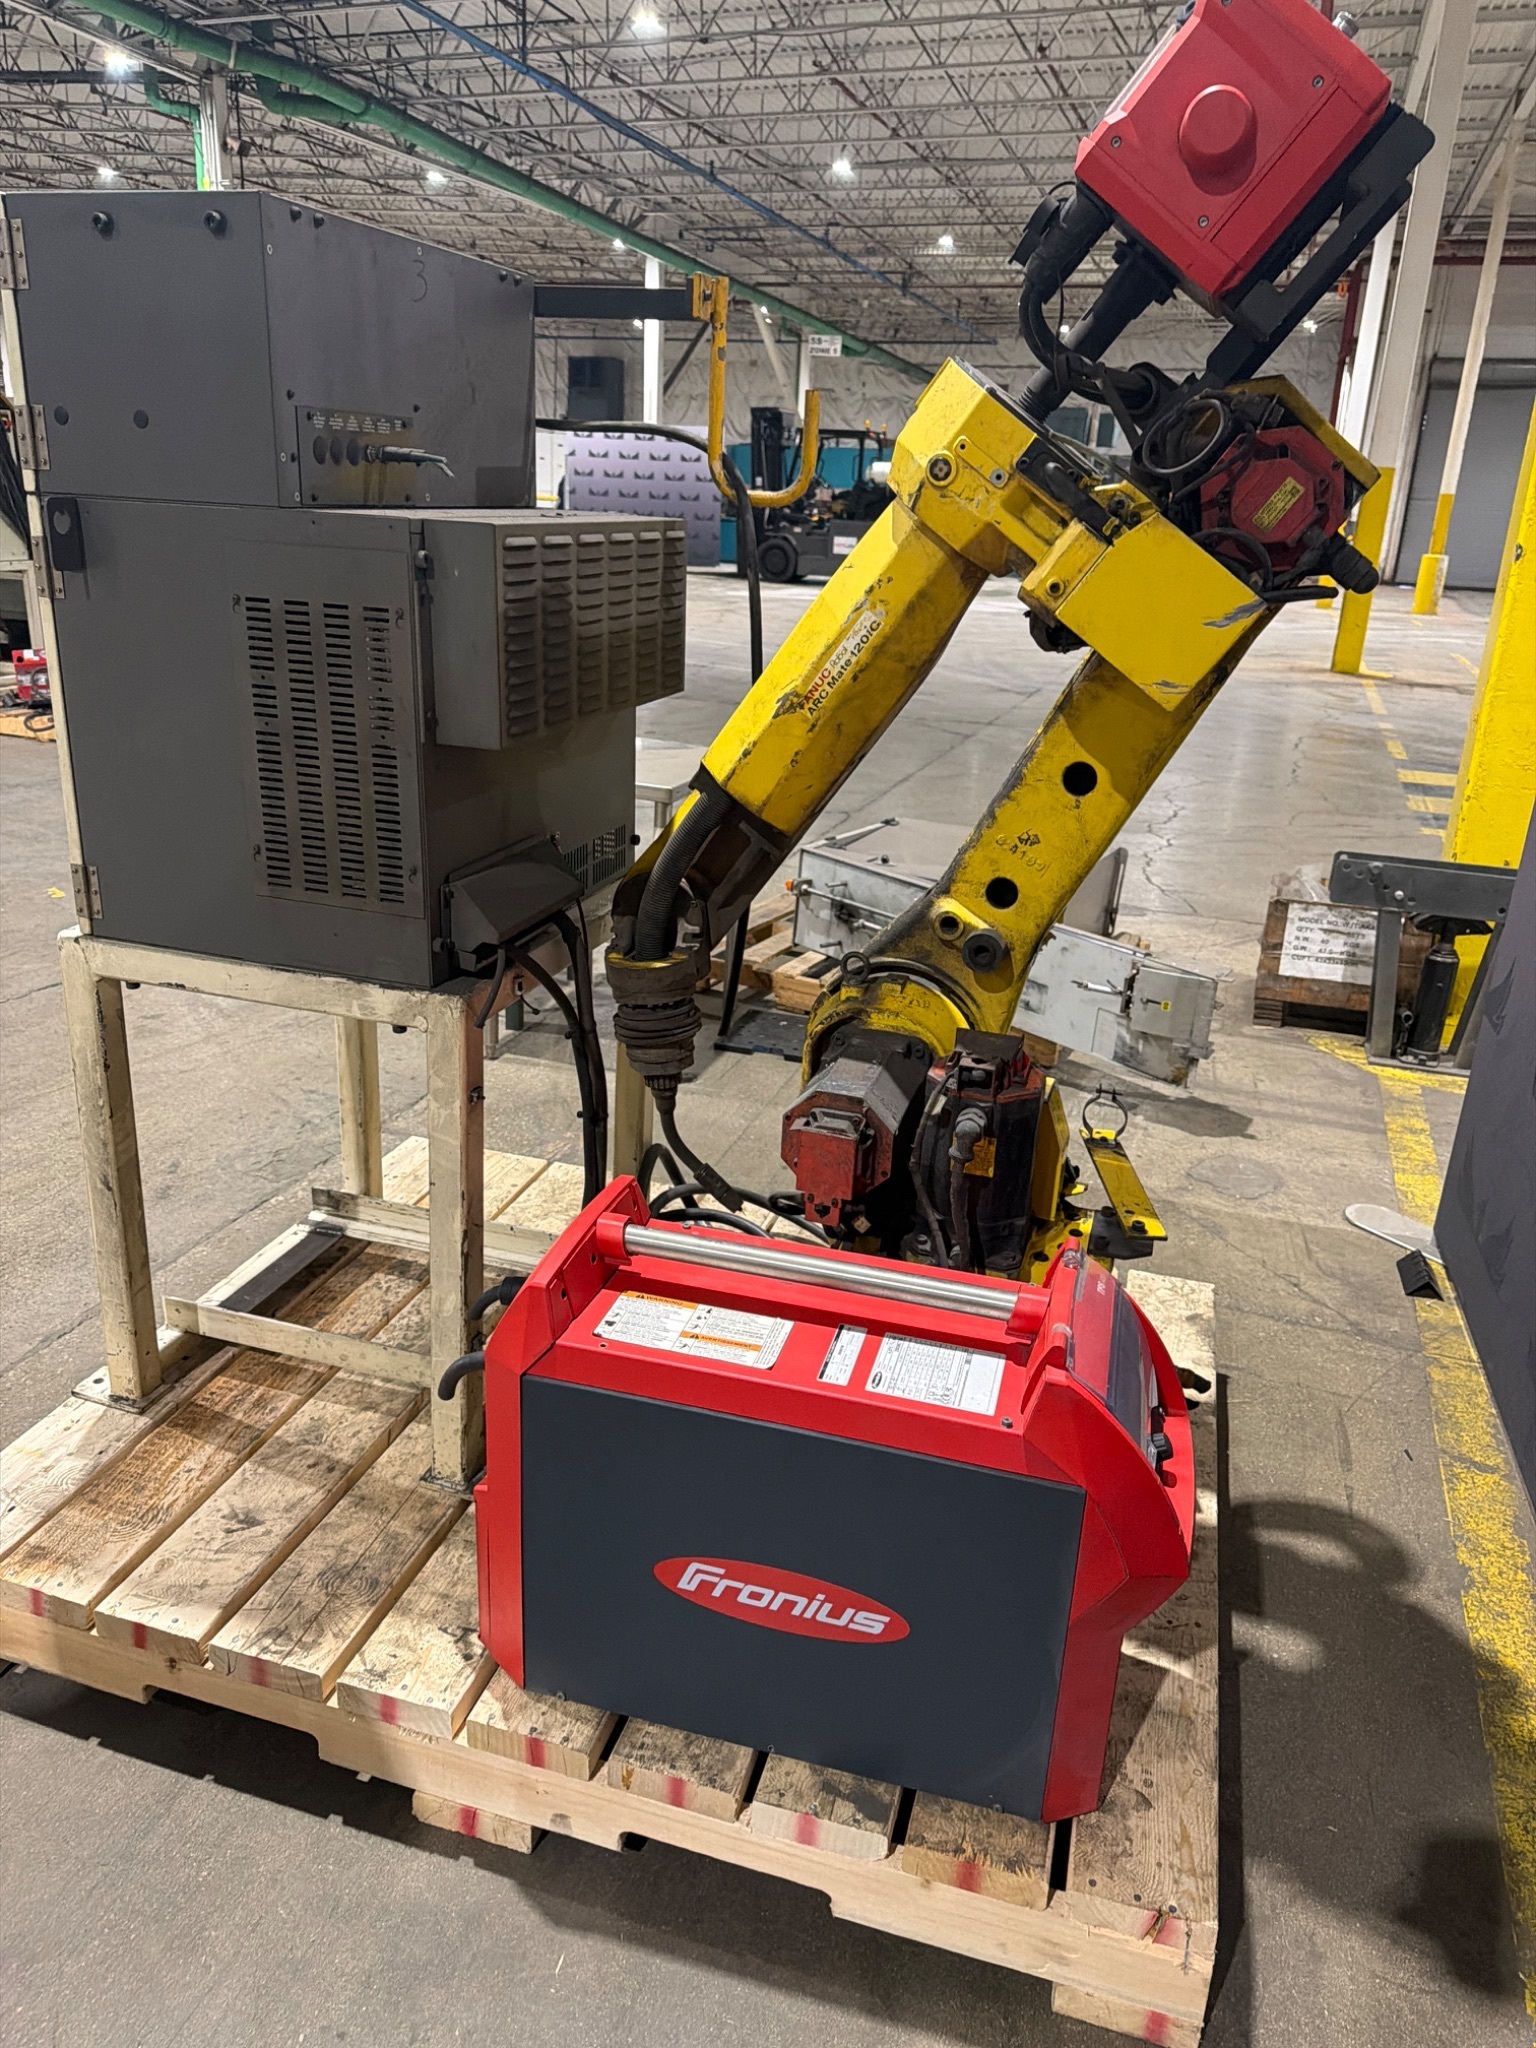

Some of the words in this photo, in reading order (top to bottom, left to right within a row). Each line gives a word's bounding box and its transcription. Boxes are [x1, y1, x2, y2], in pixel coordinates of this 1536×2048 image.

[411, 259, 428, 303] 3
[798, 667, 832, 710] FANUC
[807, 688, 830, 716] ARC
[827, 658, 852, 690] Mate
[1298, 916, 1325, 925] MODEL
[676, 1561, 891, 1635] Fronius
